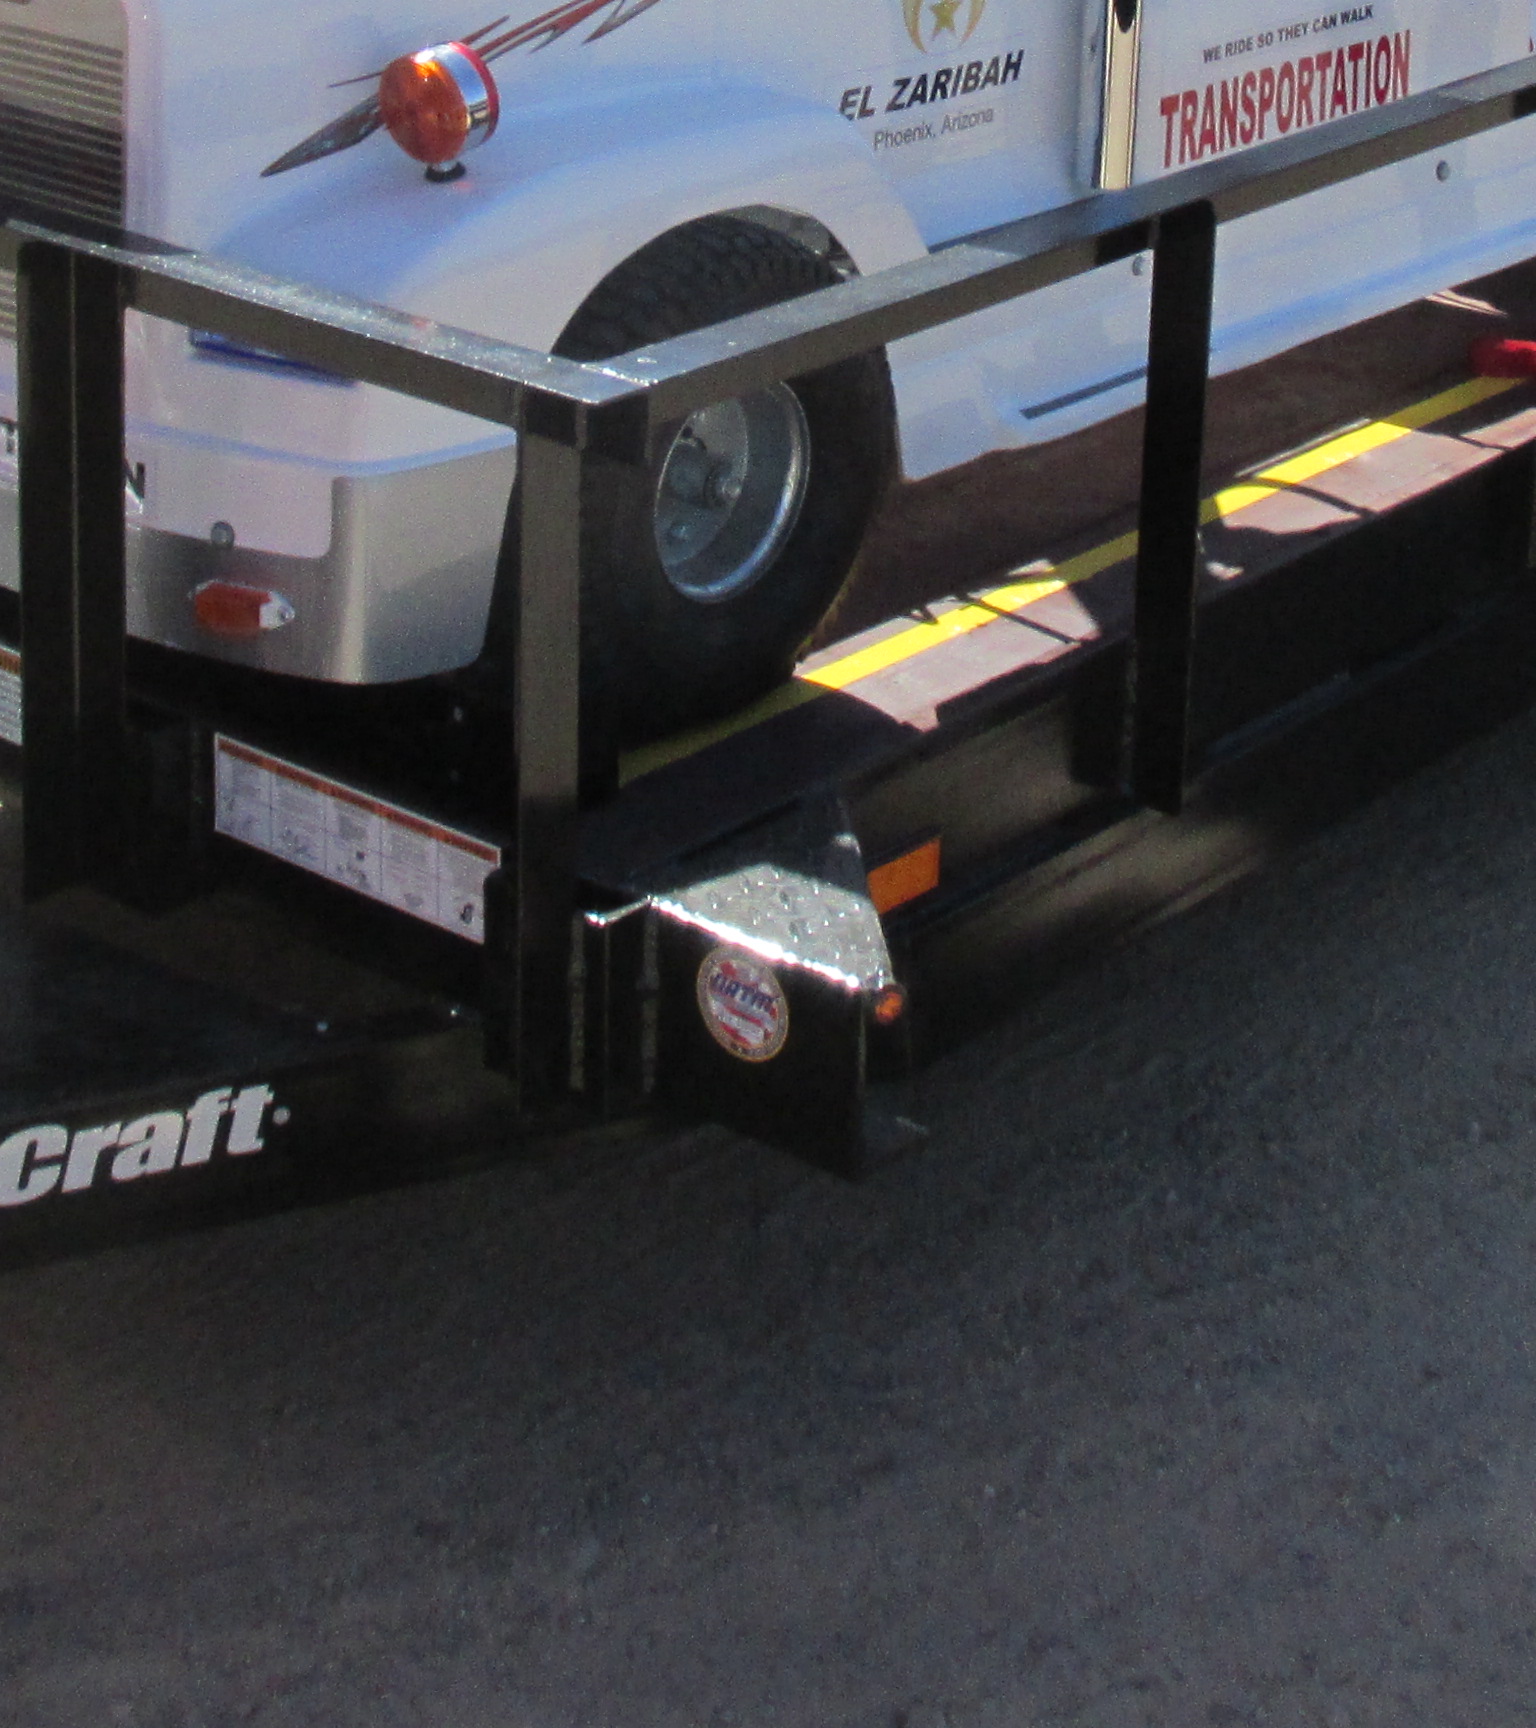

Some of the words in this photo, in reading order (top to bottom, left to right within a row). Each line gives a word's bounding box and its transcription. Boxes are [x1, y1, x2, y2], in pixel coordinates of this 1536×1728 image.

[1203, 45, 1222, 64] WE
[1224, 37, 1254, 58] RIDE
[1257, 31, 1274, 49] SO
[1277, 21, 1310, 42] THEY
[1312, 13, 1338, 34] CAN
[1339, 3, 1374, 26] WALK
[839, 85, 877, 122] EL
[885, 48, 1026, 113] ZARIBAH
[1159, 28, 1411, 170] TRANSPORTATION
[873, 122, 937, 152] Phoenix,
[940, 107, 996, 135] Arizona
